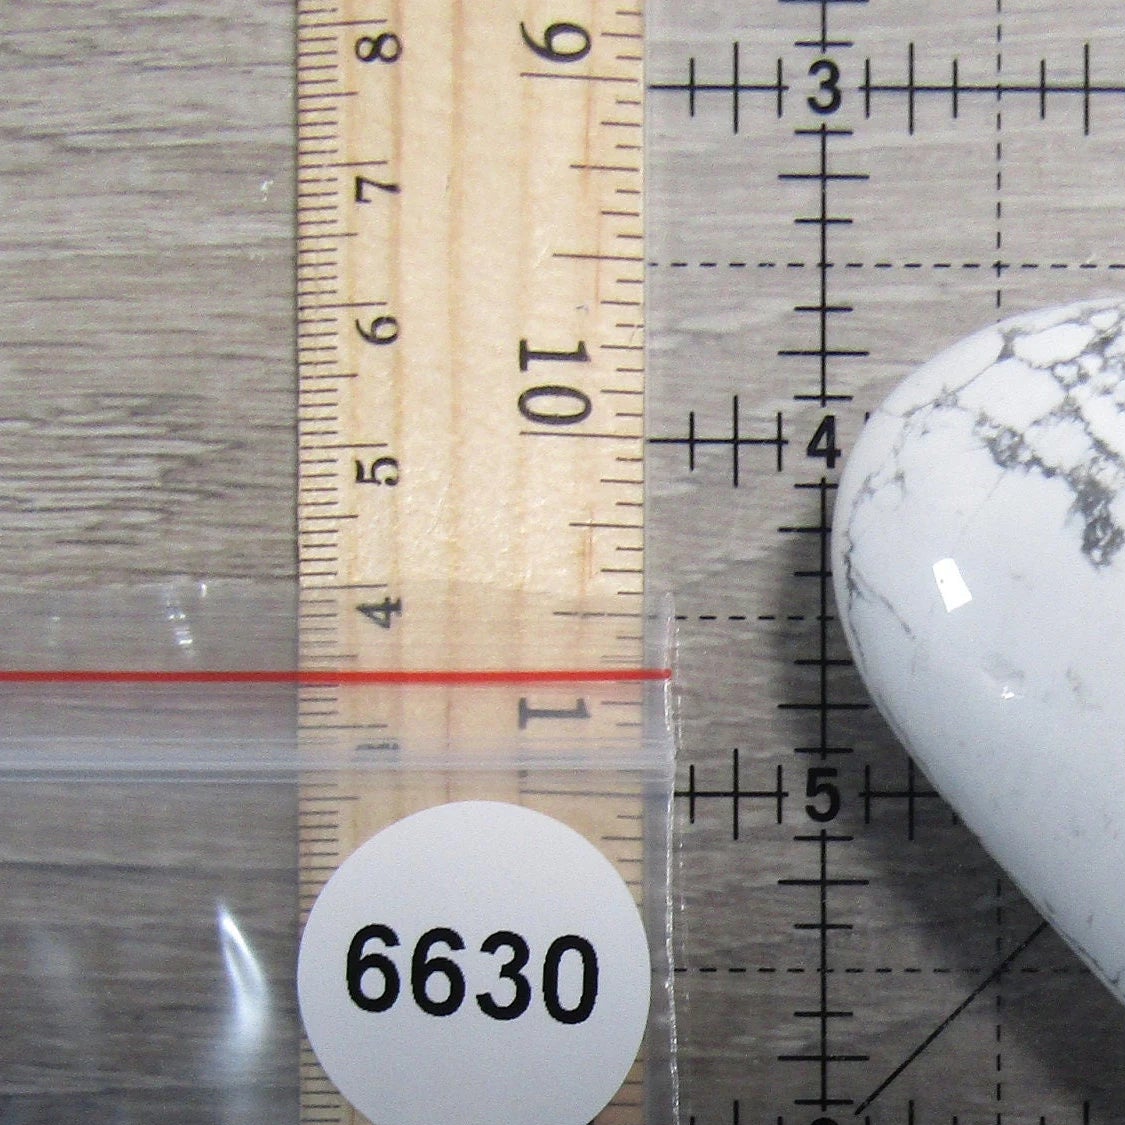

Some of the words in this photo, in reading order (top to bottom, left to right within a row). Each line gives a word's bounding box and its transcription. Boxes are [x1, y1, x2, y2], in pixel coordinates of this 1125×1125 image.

[355, 32, 403, 63] 8
[806, 59, 842, 115] 3
[355, 176, 400, 203] 7
[355, 316, 399, 345] 6
[518, 338, 592, 426] 10
[806, 414, 842, 469] 4
[355, 456, 399, 486] 5
[355, 597, 402, 629] 4
[805, 767, 841, 823] 5
[346, 923, 600, 1025] 6630
